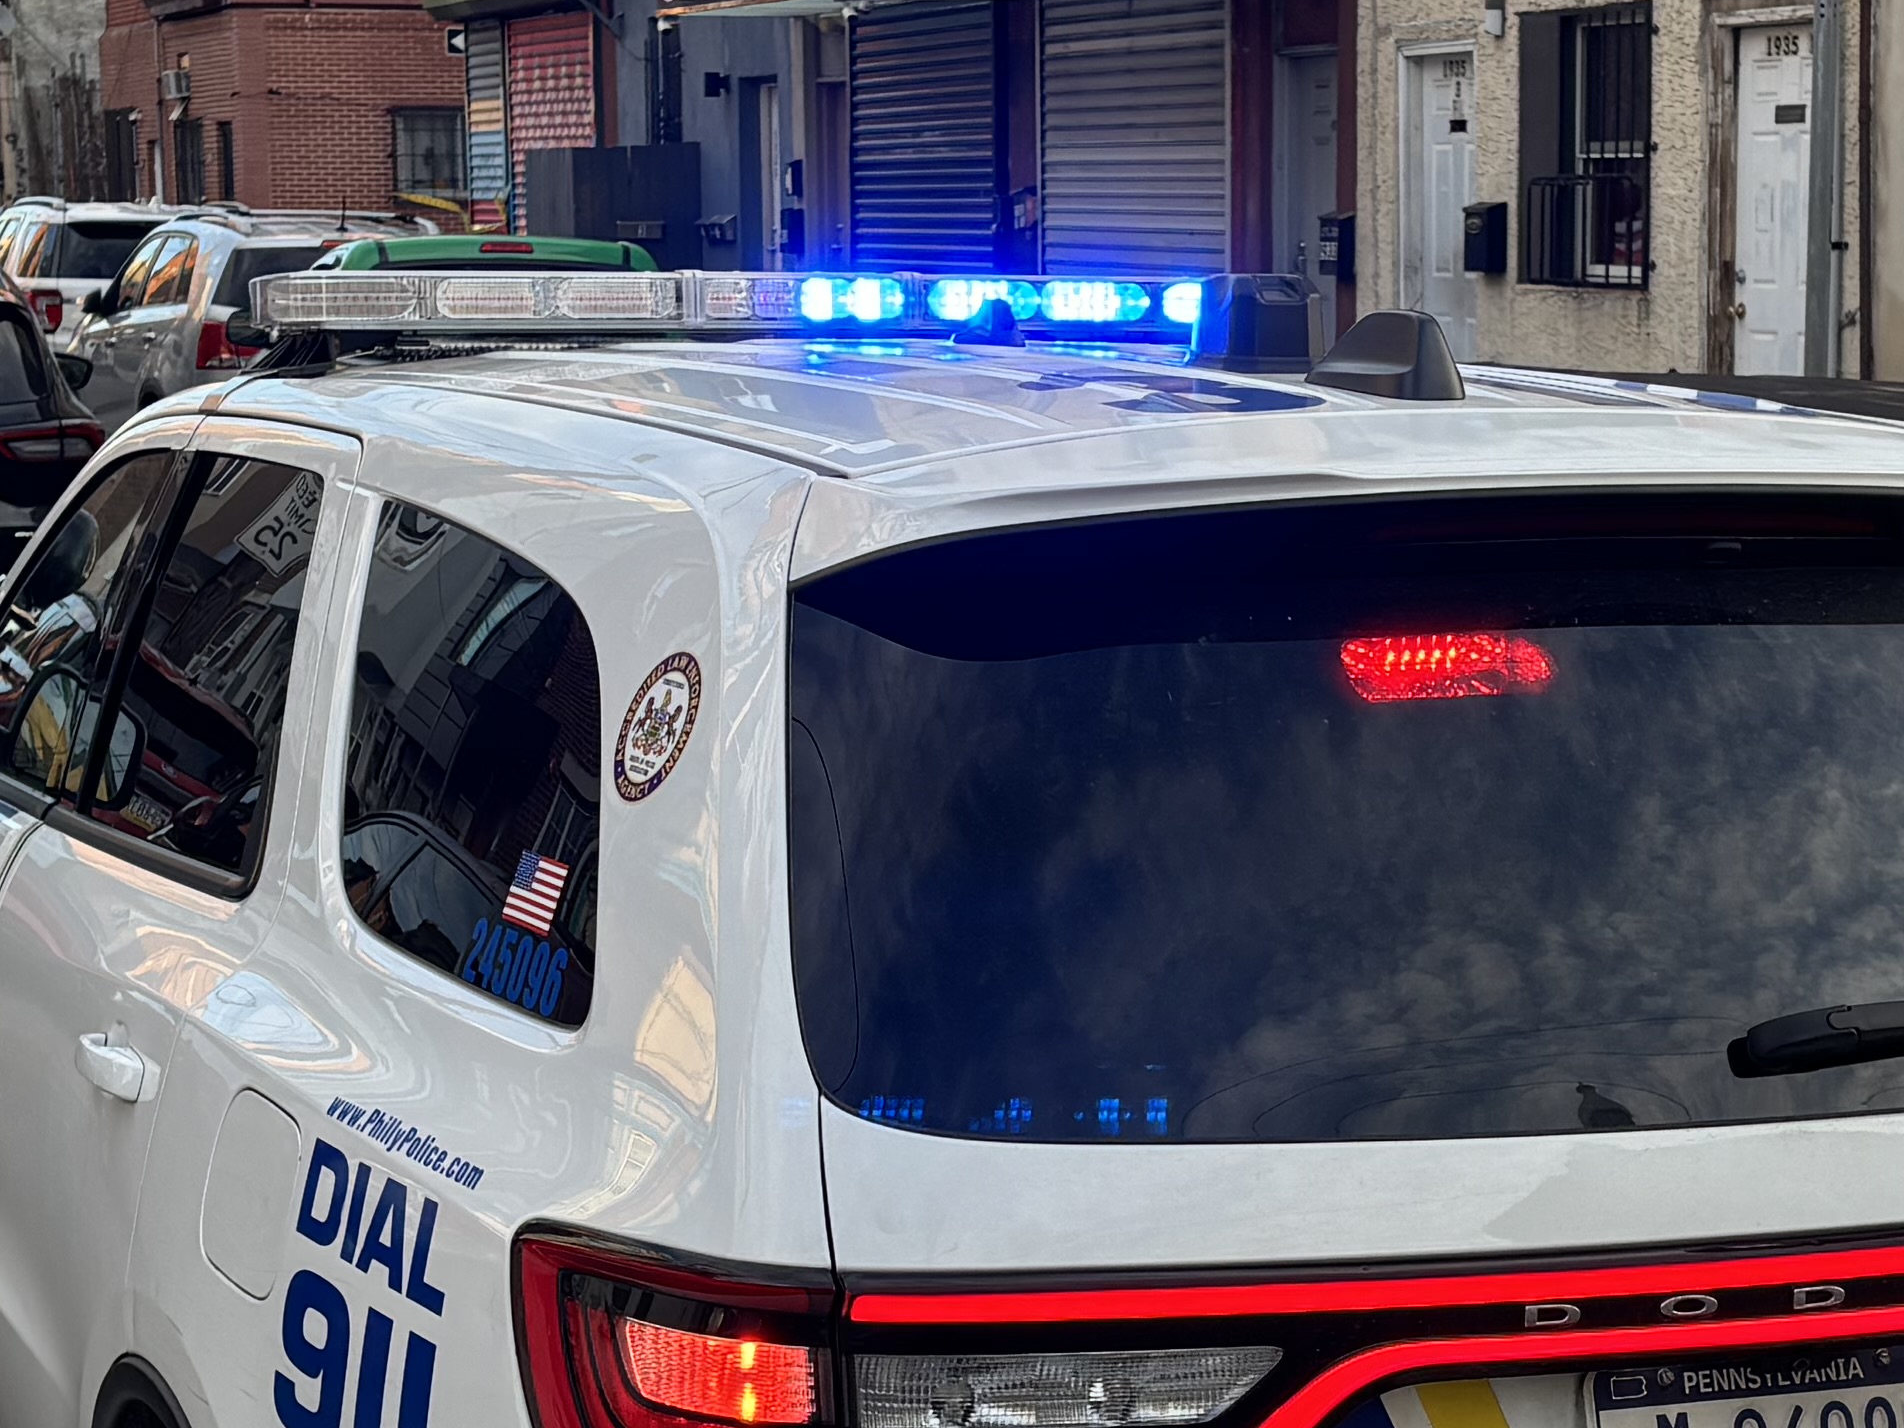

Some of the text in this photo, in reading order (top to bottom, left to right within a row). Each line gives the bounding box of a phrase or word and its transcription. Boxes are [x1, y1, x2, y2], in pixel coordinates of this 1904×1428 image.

[1766, 35, 1799, 57] 1935
[461, 916, 569, 1018] 245096
[325, 1095, 485, 1192] www.PhillyPolice.com
[296, 1137, 446, 1318] DIAL
